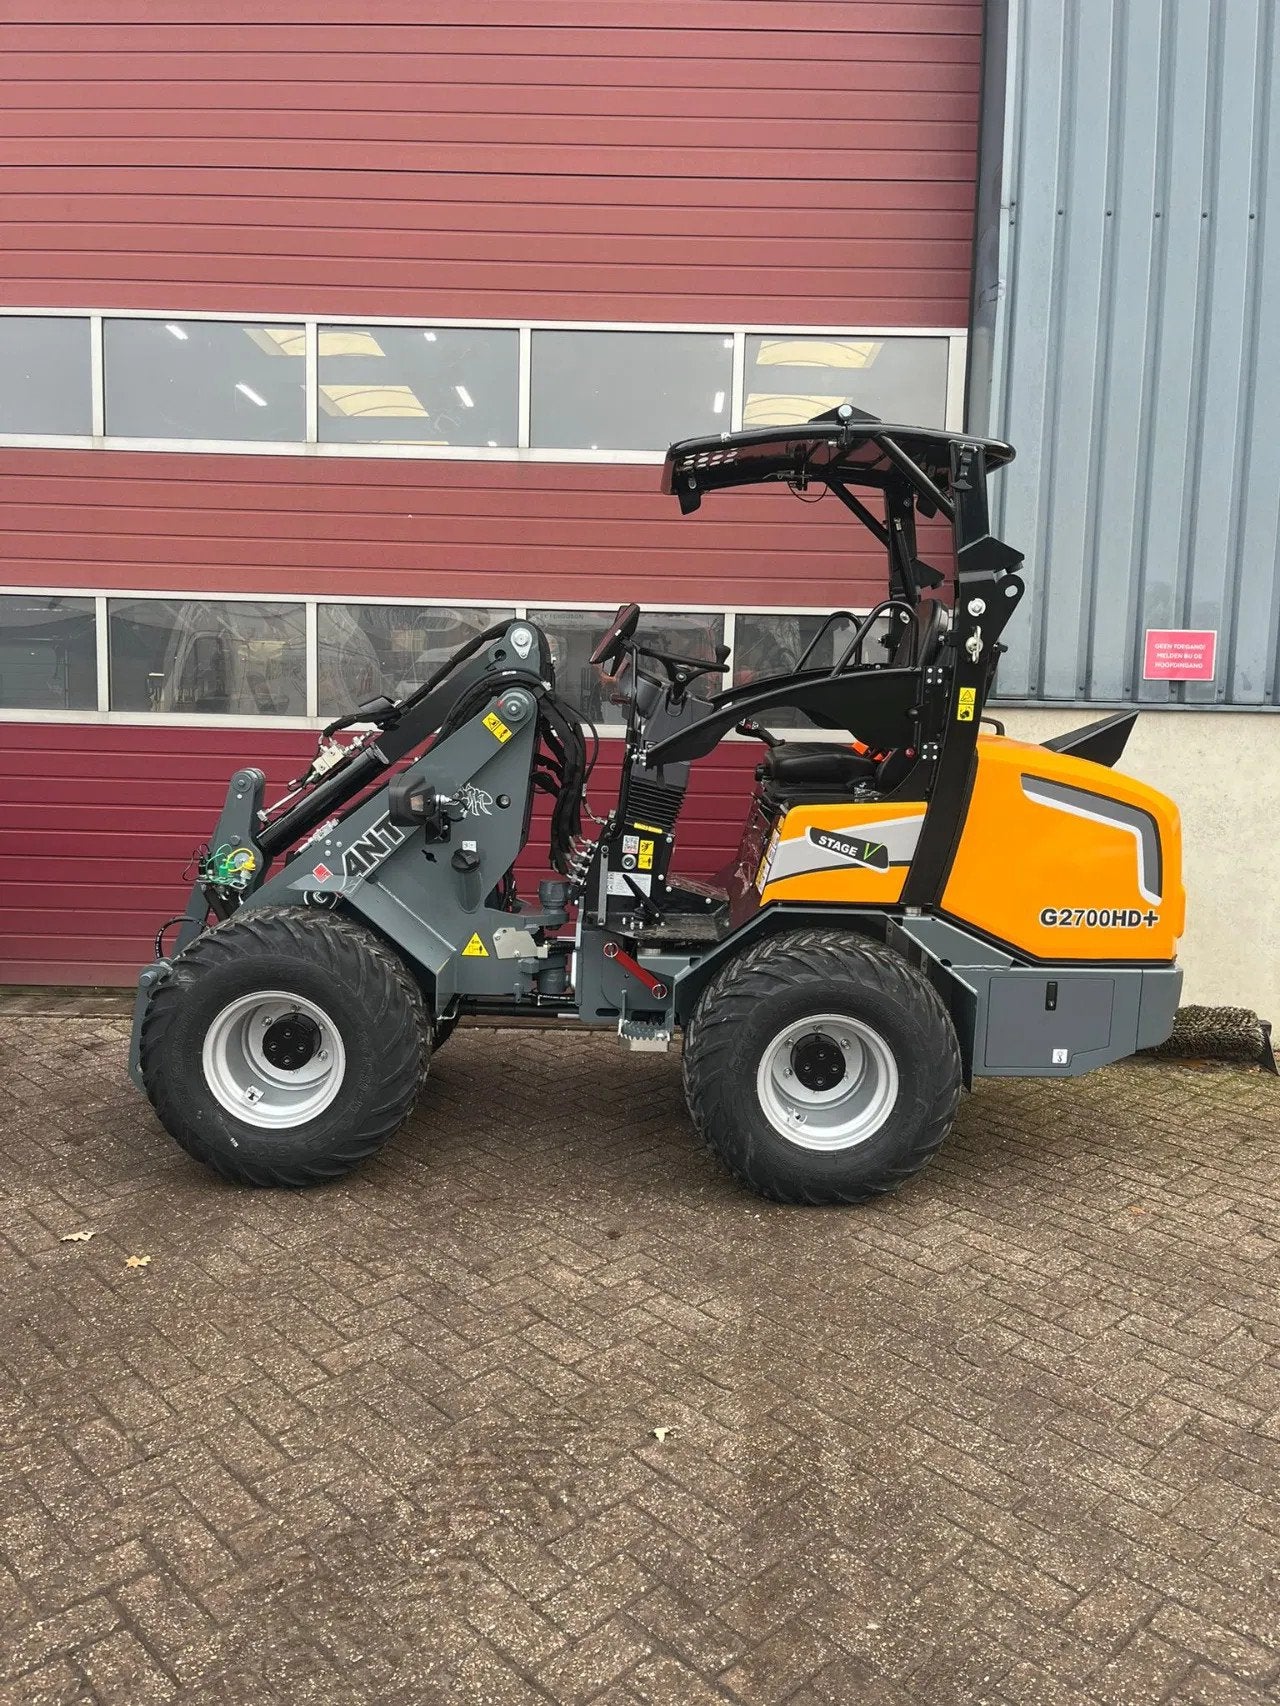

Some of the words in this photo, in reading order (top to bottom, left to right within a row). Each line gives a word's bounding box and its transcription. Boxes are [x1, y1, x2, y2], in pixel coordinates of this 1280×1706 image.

[818, 835, 859, 857] STAGE
[863, 842, 884, 861] V
[1039, 907, 1160, 929] G2700HD+
